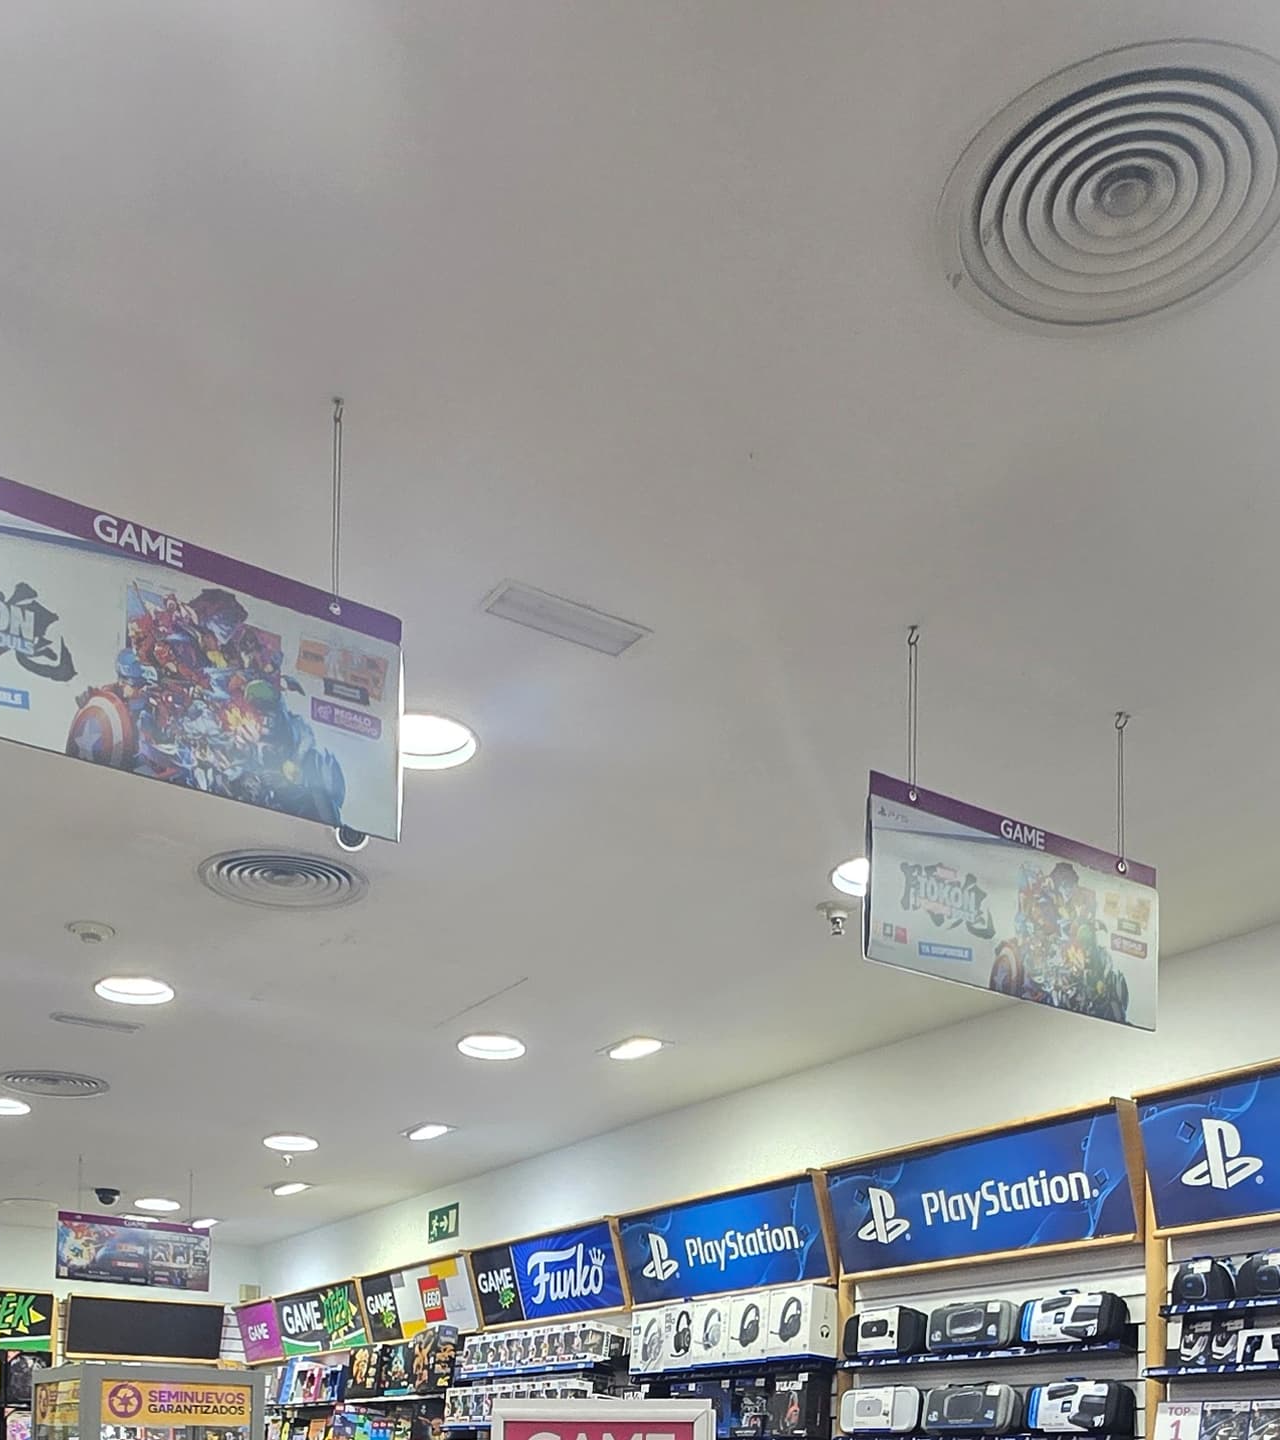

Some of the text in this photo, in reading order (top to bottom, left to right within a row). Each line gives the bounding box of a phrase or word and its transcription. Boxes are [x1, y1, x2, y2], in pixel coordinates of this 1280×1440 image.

[94, 515, 183, 567] GAME
[1000, 820, 1045, 850] GAME
[922, 1170, 1092, 1229] PlayStation
[686, 1224, 799, 1270] PlayStation
[478, 1243, 604, 1304] GAME Funko
[282, 1301, 323, 1334] GAME
[366, 1290, 440, 1317] GAME LEGO
[248, 1323, 269, 1341] GAME
[148, 1404, 244, 1415] GARANTIZADOS
[149, 1390, 244, 1404] SEMINUEVOS
[1169, 1407, 1190, 1416] TOP
